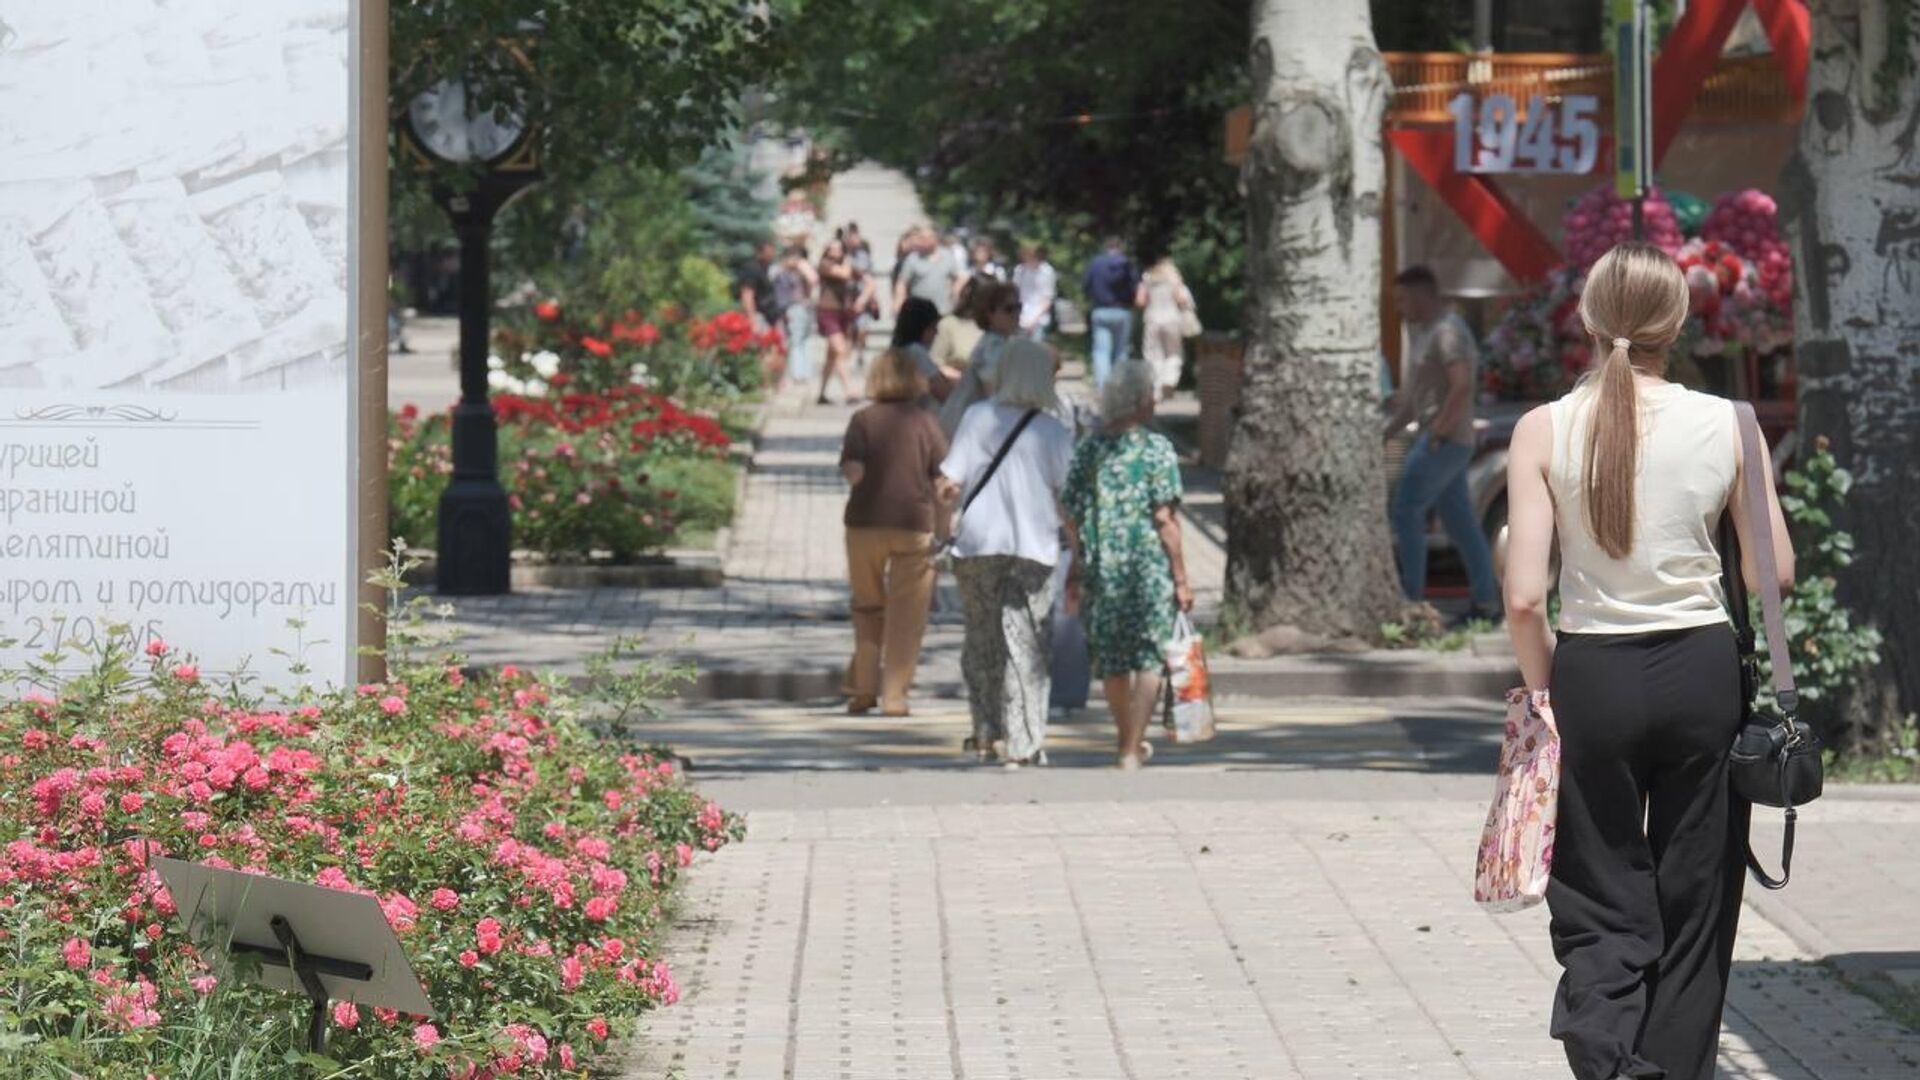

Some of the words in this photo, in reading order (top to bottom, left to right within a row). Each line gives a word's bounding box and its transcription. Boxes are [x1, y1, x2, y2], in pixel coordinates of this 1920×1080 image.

[1448, 93, 1599, 175] 1945
[0, 528, 170, 559] елятиной
[97, 579, 114, 604] и
[129, 579, 336, 619] помидорами
[23, 615, 96, 656] 270
